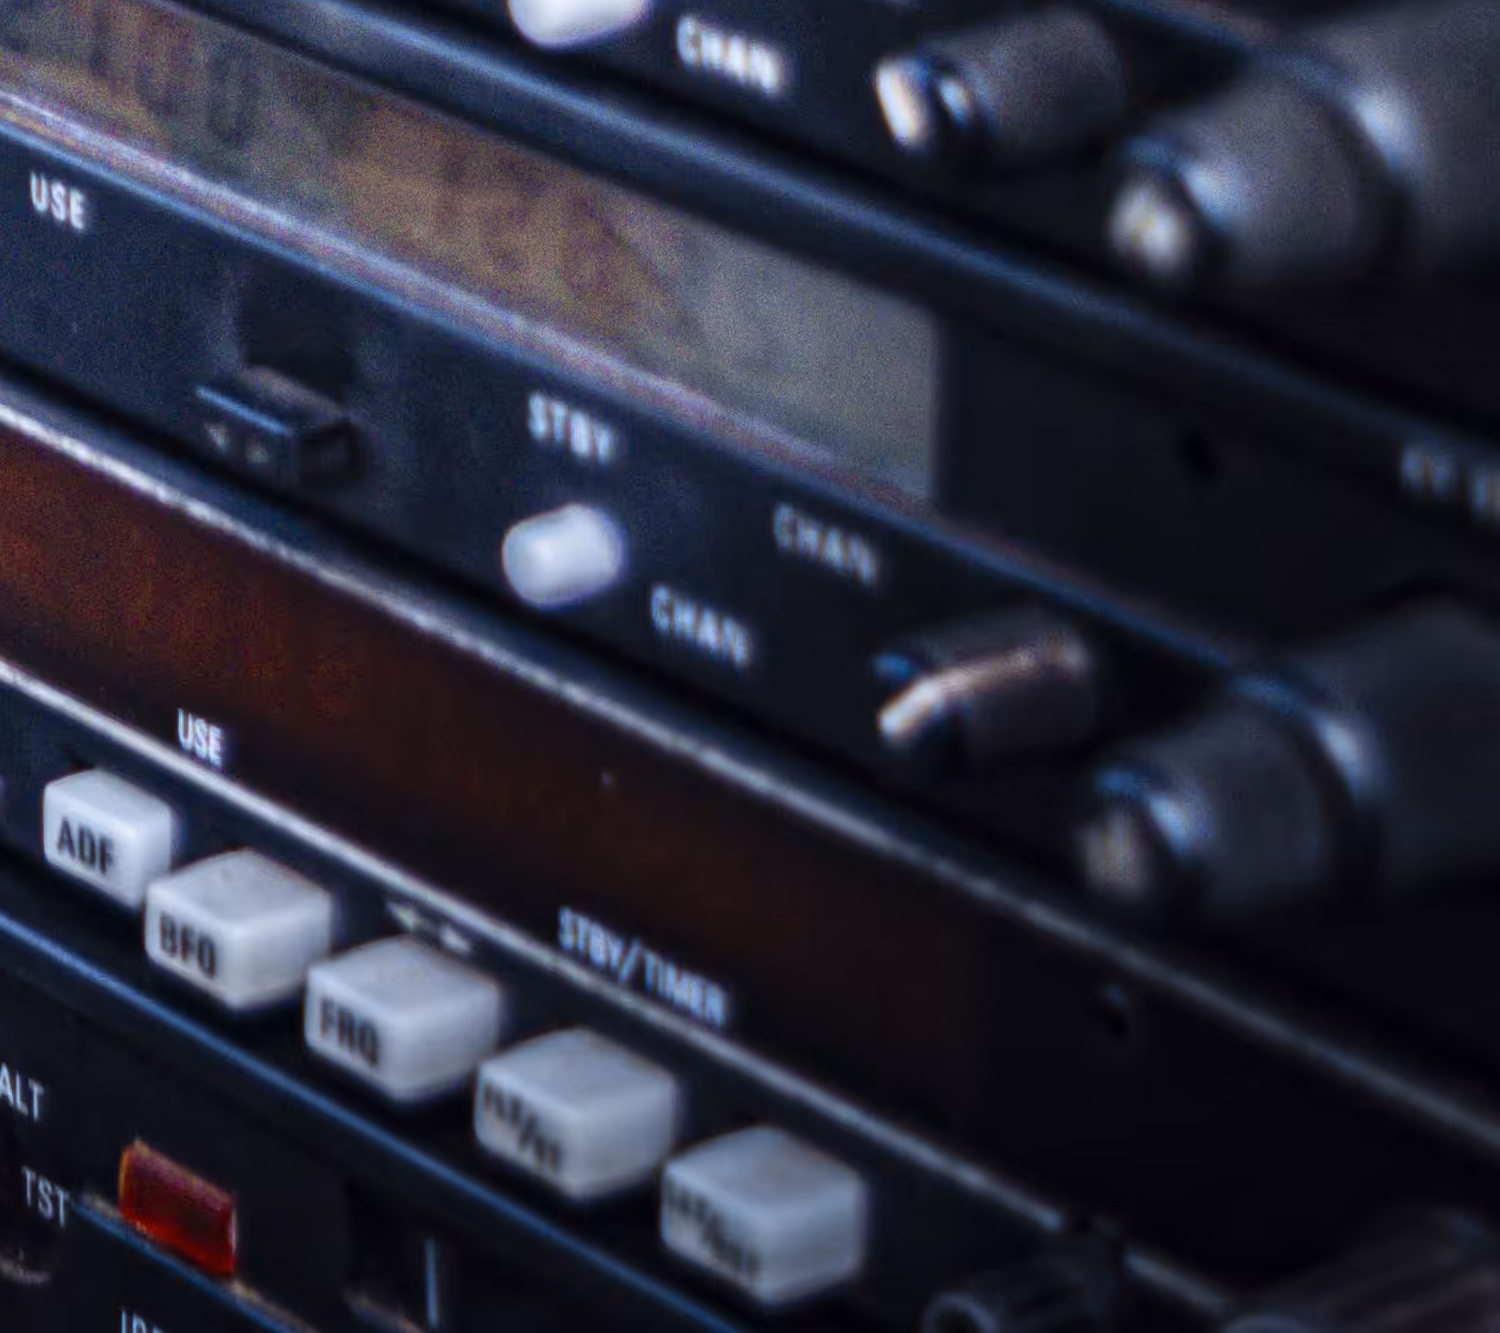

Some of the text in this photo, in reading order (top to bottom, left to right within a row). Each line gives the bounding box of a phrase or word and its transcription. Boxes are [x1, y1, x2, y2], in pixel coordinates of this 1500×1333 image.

[676, 13, 783, 96] CHAN
[29, 172, 86, 231] USE
[528, 393, 619, 465] STBY
[650, 584, 751, 670] CHAN
[177, 708, 224, 768] USE
[56, 815, 114, 876] ADF
[159, 912, 217, 981] BFO
[20, 1165, 73, 1227] TST
